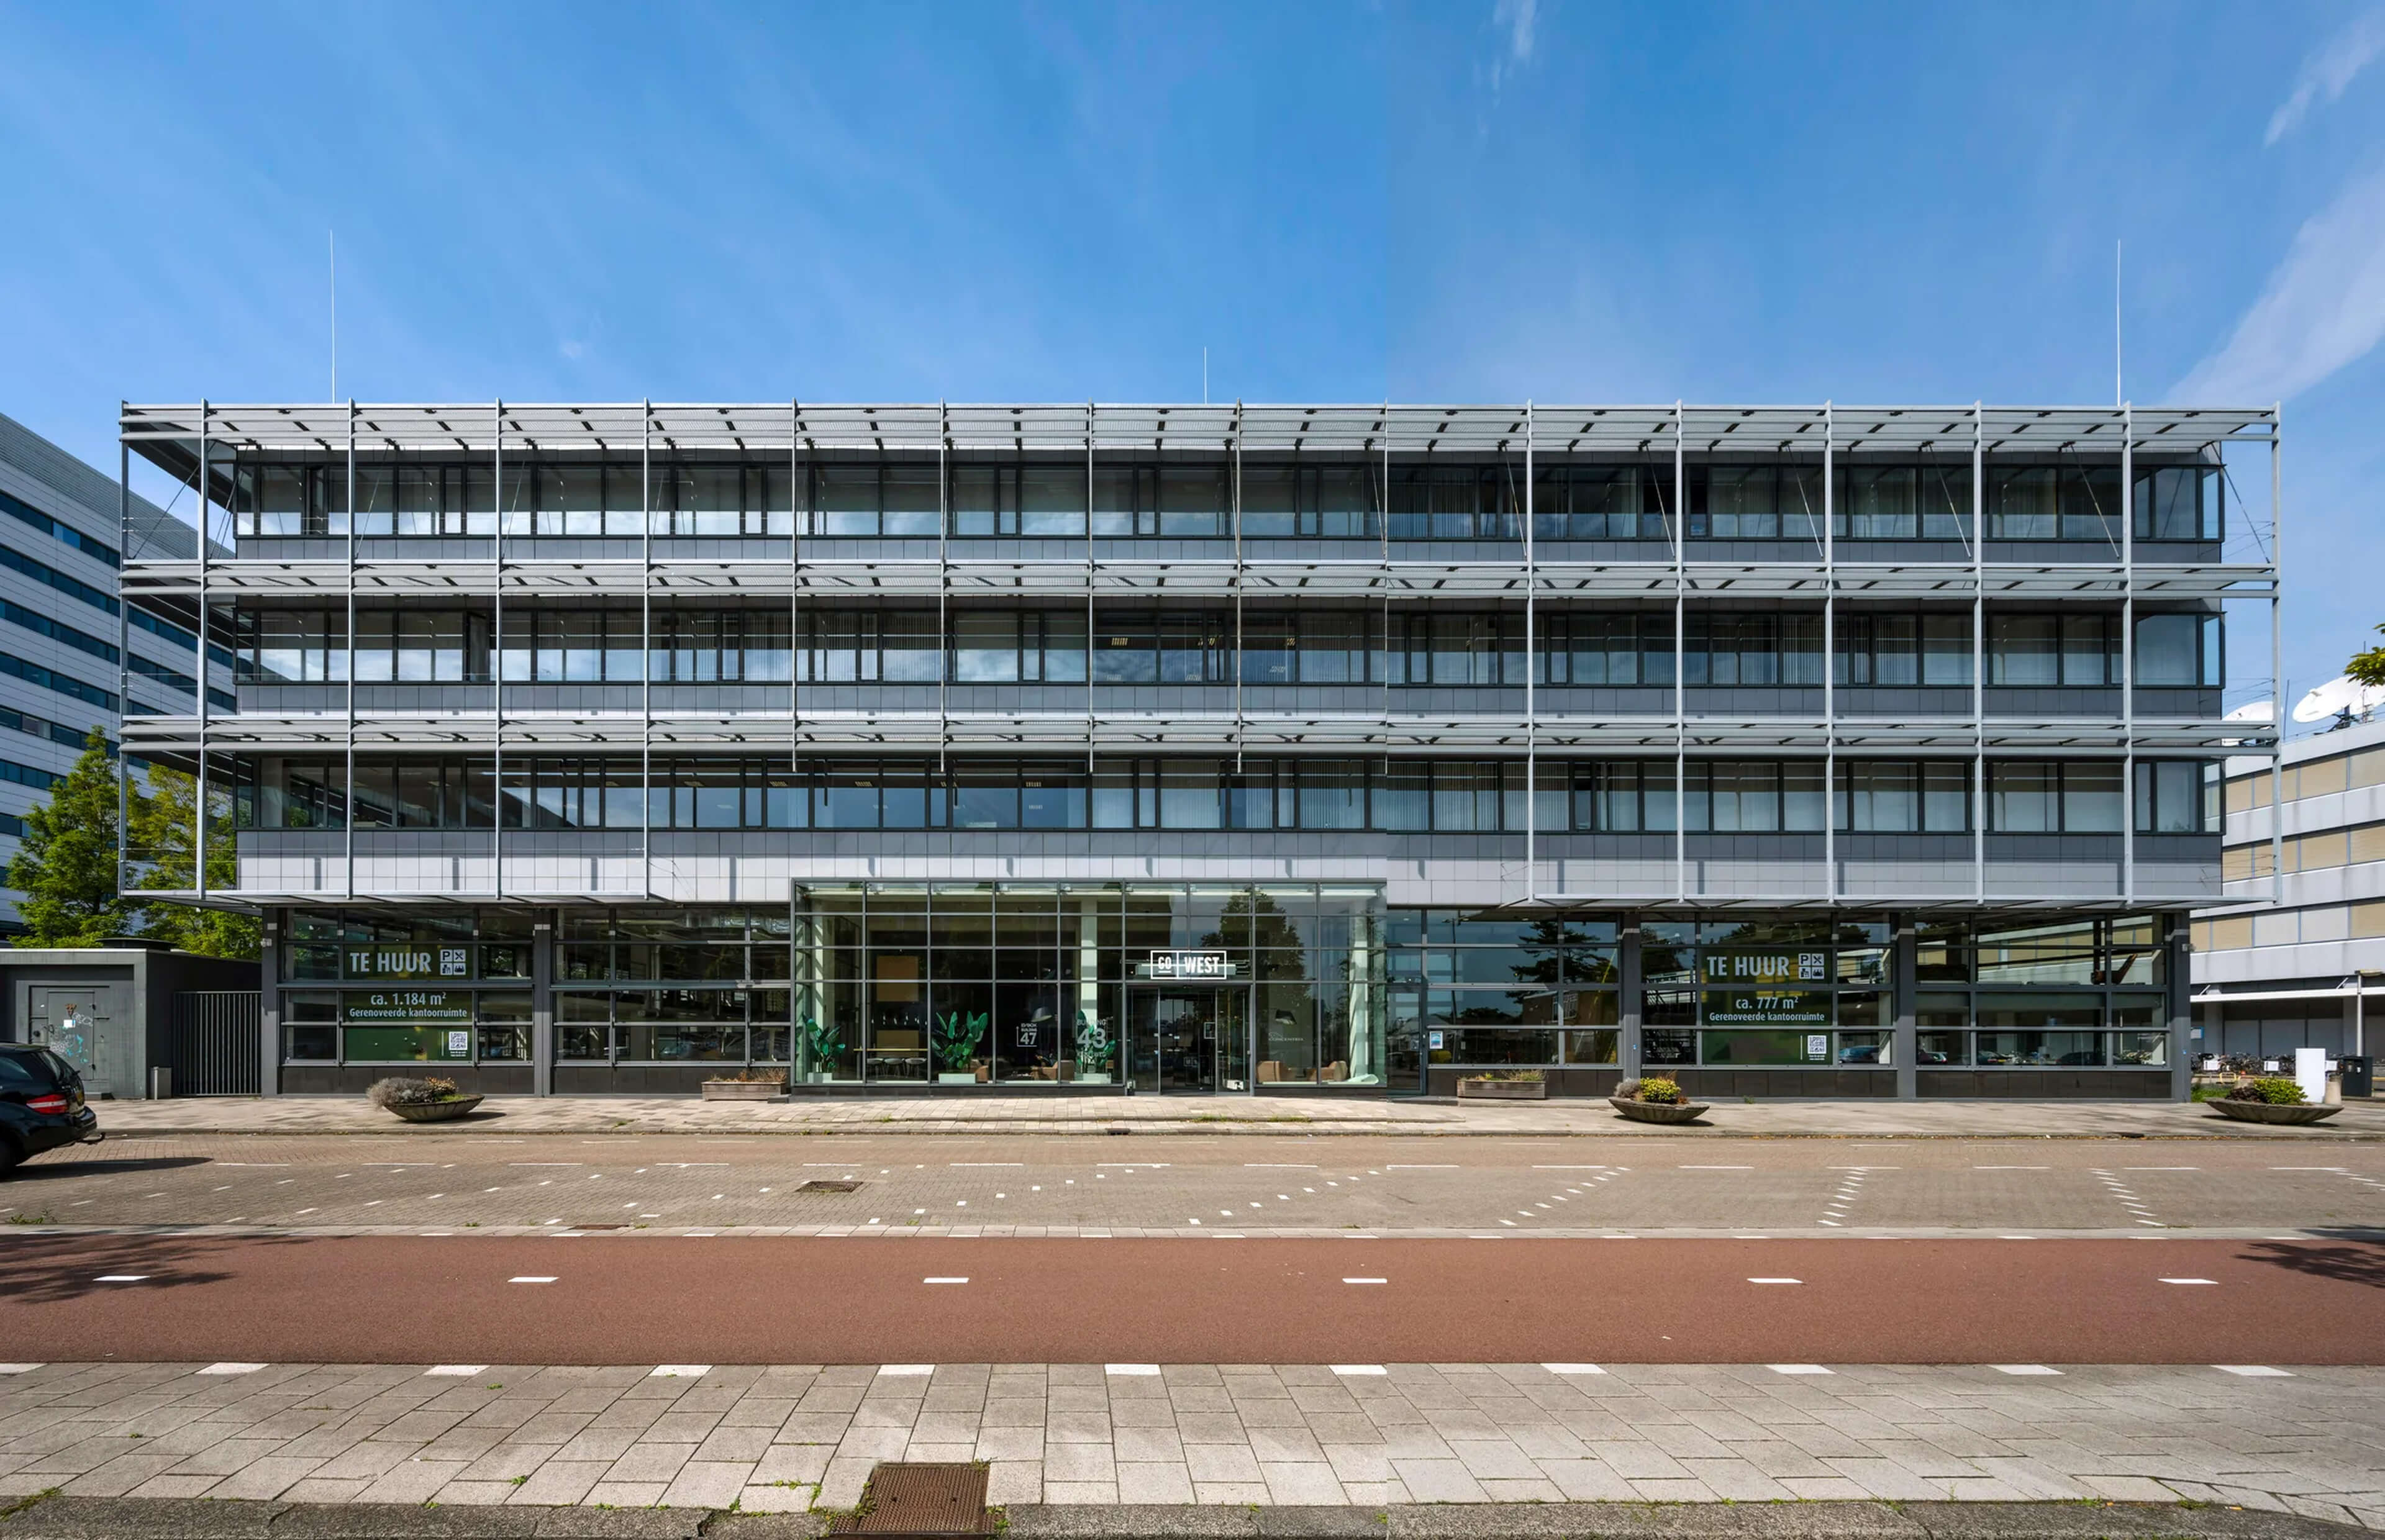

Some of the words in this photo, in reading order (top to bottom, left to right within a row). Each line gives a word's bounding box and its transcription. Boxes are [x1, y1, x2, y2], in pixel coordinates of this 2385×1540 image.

[350, 952, 370, 972] TE
[377, 952, 432, 972] HUUR
[1158, 956, 1171, 970] GO
[1184, 956, 1220, 974] WEST
[1707, 956, 1727, 976] TE
[1735, 956, 1789, 976] HUUR
[370, 995, 388, 1005] ca.
[392, 992, 426, 1005] 1.184
[1735, 999, 1753, 1009] ca.
[1756, 997, 1778, 1009] 777
[349, 1007, 407, 1017] Gerenoveerde
[409, 1007, 468, 1017] kantoorruimte
[1709, 1012, 1766, 1021] Gerenoveerde
[1767, 1012, 1825, 1021] kantoorruimte
[1020, 1032, 1037, 1045] 47
[1076, 1028, 1106, 1049] 43
